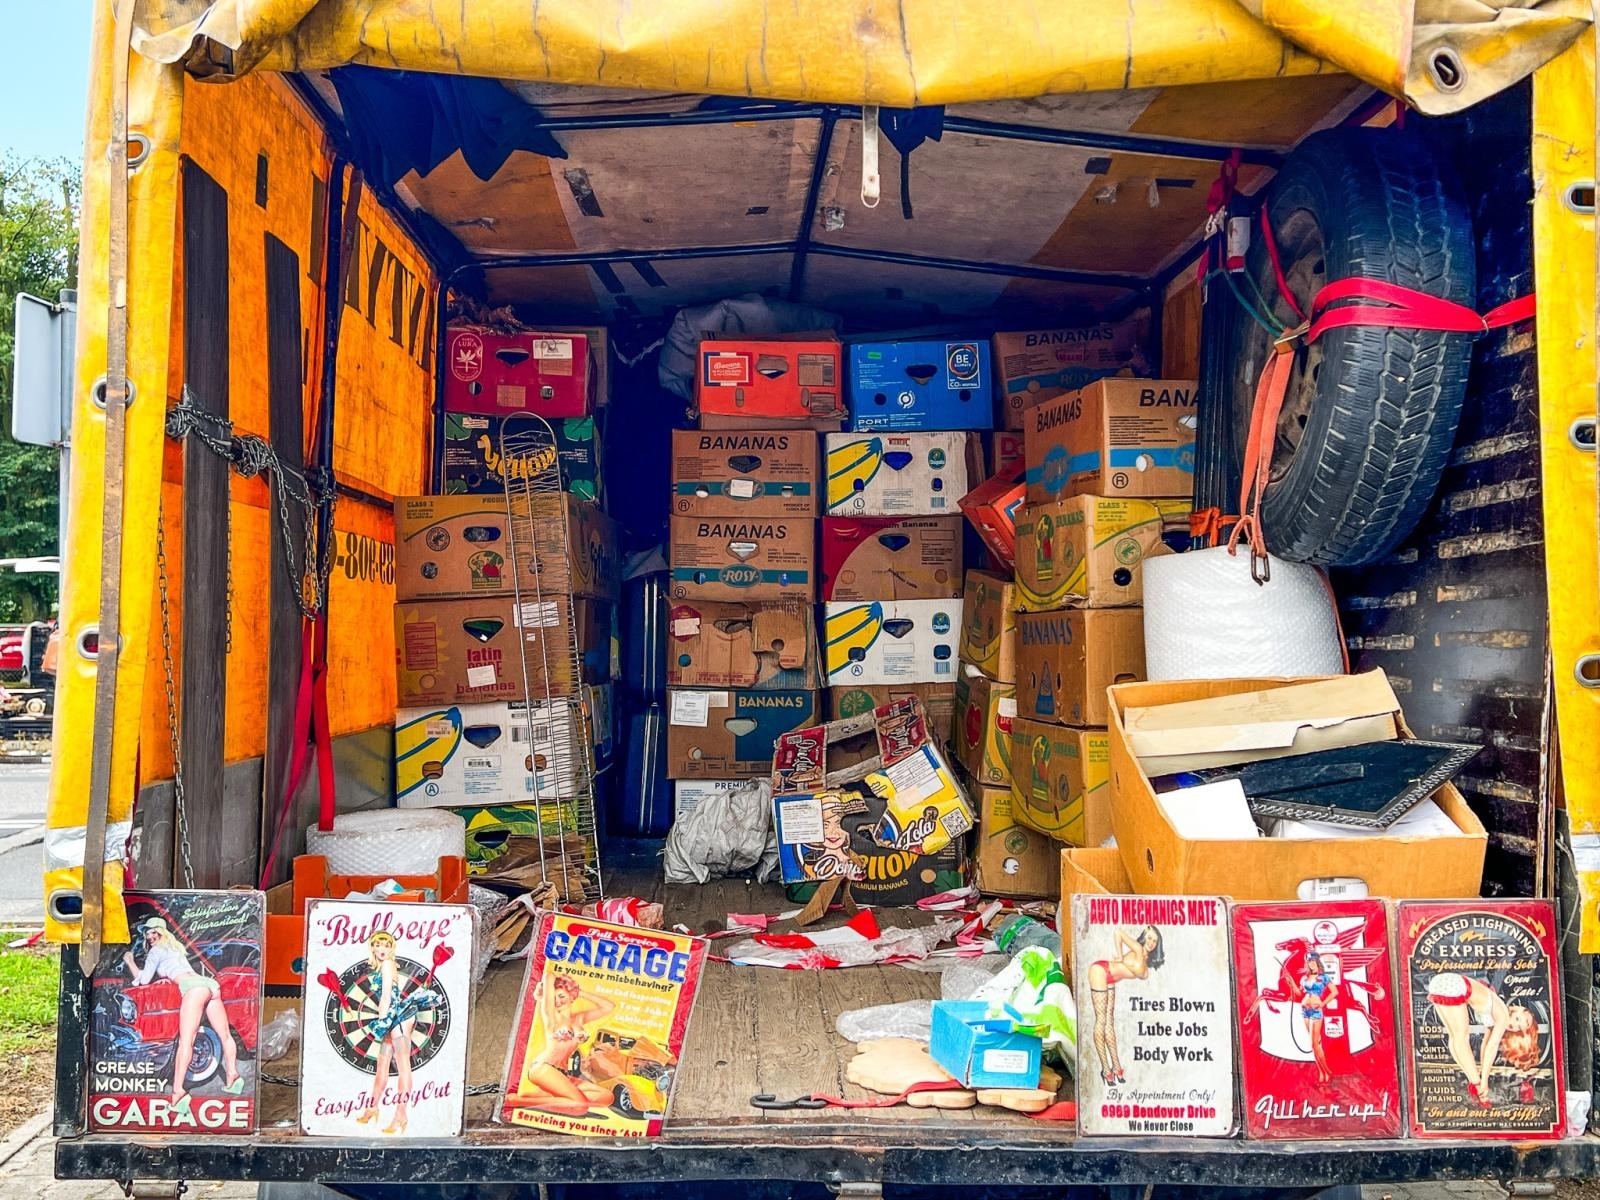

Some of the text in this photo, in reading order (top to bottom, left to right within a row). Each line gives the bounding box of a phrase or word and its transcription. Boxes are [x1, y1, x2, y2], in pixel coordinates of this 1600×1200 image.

[1025, 327, 1114, 347] BANANAS
[956, 354, 969, 364] BE
[1139, 388, 1198, 407] BANA
[1036, 398, 1082, 433] BANANAS
[699, 436, 789, 450] BANANAS
[697, 523, 787, 539] BANANAS
[725, 570, 757, 582] ROSY
[1022, 617, 1073, 646] BANANAS
[467, 647, 502, 662] latin
[738, 696, 804, 708] BANANAS
[897, 818, 935, 850] Lola
[878, 878, 909, 891] BANANAS
[182, 904, 239, 919] Satisfaction
[1090, 899, 1218, 926] AUTO MECHANICS MATE
[189, 913, 250, 931] Guaranteed!
[587, 927, 659, 948] Full Service
[1421, 917, 1537, 956] GREASED LIGHTNING
[544, 930, 691, 983] GARAGE
[1439, 944, 1517, 958] EXPRESS
[1485, 959, 1512, 970] Lube
[553, 964, 674, 992] Is your car misbehaving?
[1504, 974, 1530, 985] Open
[1511, 986, 1543, 997] Late!
[1129, 997, 1215, 1013] Tires Blown
[1138, 1021, 1208, 1037] Lube Jobs
[1420, 1026, 1442, 1034] RODS
[1133, 1046, 1214, 1064] Body Work
[95, 1061, 155, 1074] GREASE
[95, 1077, 168, 1093] MONKEY
[420, 1081, 451, 1099] Out
[1106, 1088, 1216, 1104] By Appointment Only!
[93, 1097, 250, 1128] GARAGE
[1101, 1105, 1216, 1118] 6969 Bendover Drive
[1255, 1092, 1389, 1128] Fill her up!
[1445, 1107, 1468, 1118] and
[1469, 1107, 1488, 1118] out
[1489, 1107, 1502, 1118] in
[517, 1111, 566, 1130] Servicing
[569, 1120, 588, 1133] you
[591, 1124, 617, 1137] since
[1128, 1120, 1194, 1131] We Never Close
